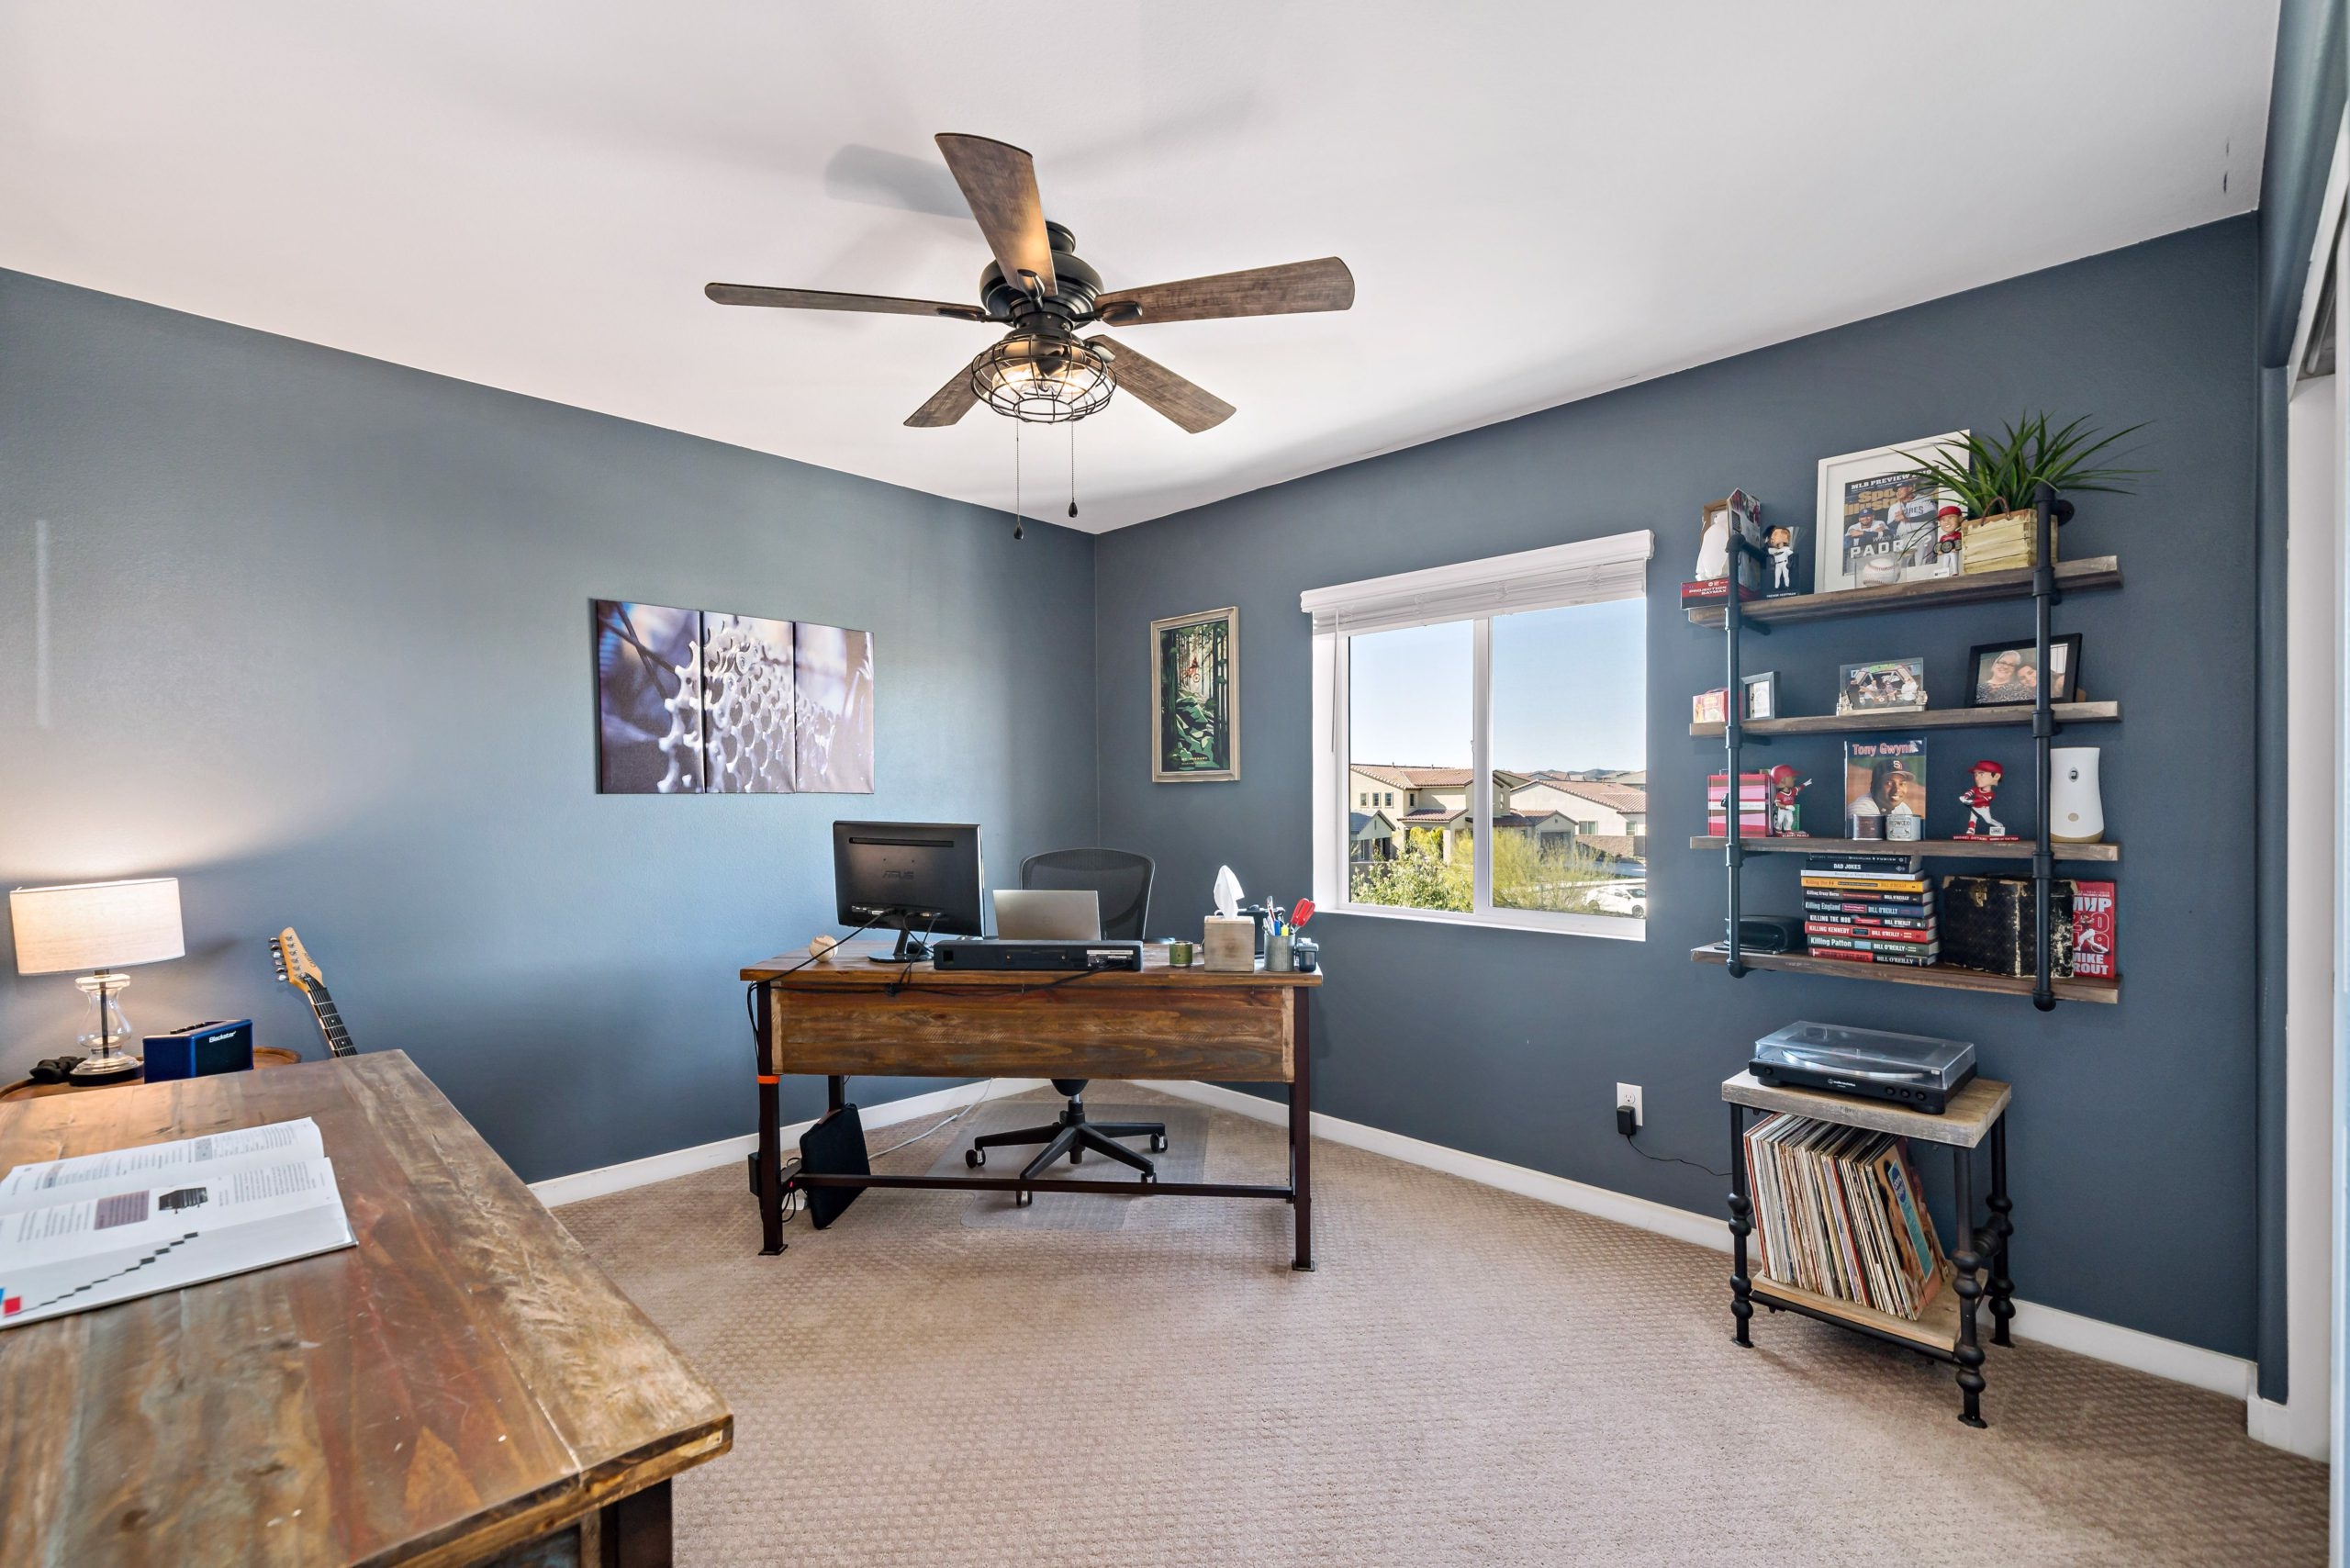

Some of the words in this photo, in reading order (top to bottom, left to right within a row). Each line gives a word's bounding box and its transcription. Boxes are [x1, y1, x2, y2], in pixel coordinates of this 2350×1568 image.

[1851, 482, 1869, 490] MLB
[1870, 473, 1910, 487] PREVIEW
[1911, 469, 1932, 478] 219
[1852, 744, 1876, 756] Tony
[882, 870, 914, 879] ASUS
[1806, 902, 1820, 911] Killing
[1821, 902, 1841, 912] England
[1810, 937, 1830, 946] Killing
[1830, 938, 1852, 947] Patton
[1889, 956, 1913, 964] O'REILLY
[2073, 963, 2109, 975] ROUT
[208, 1030, 237, 1043] Blackstar
